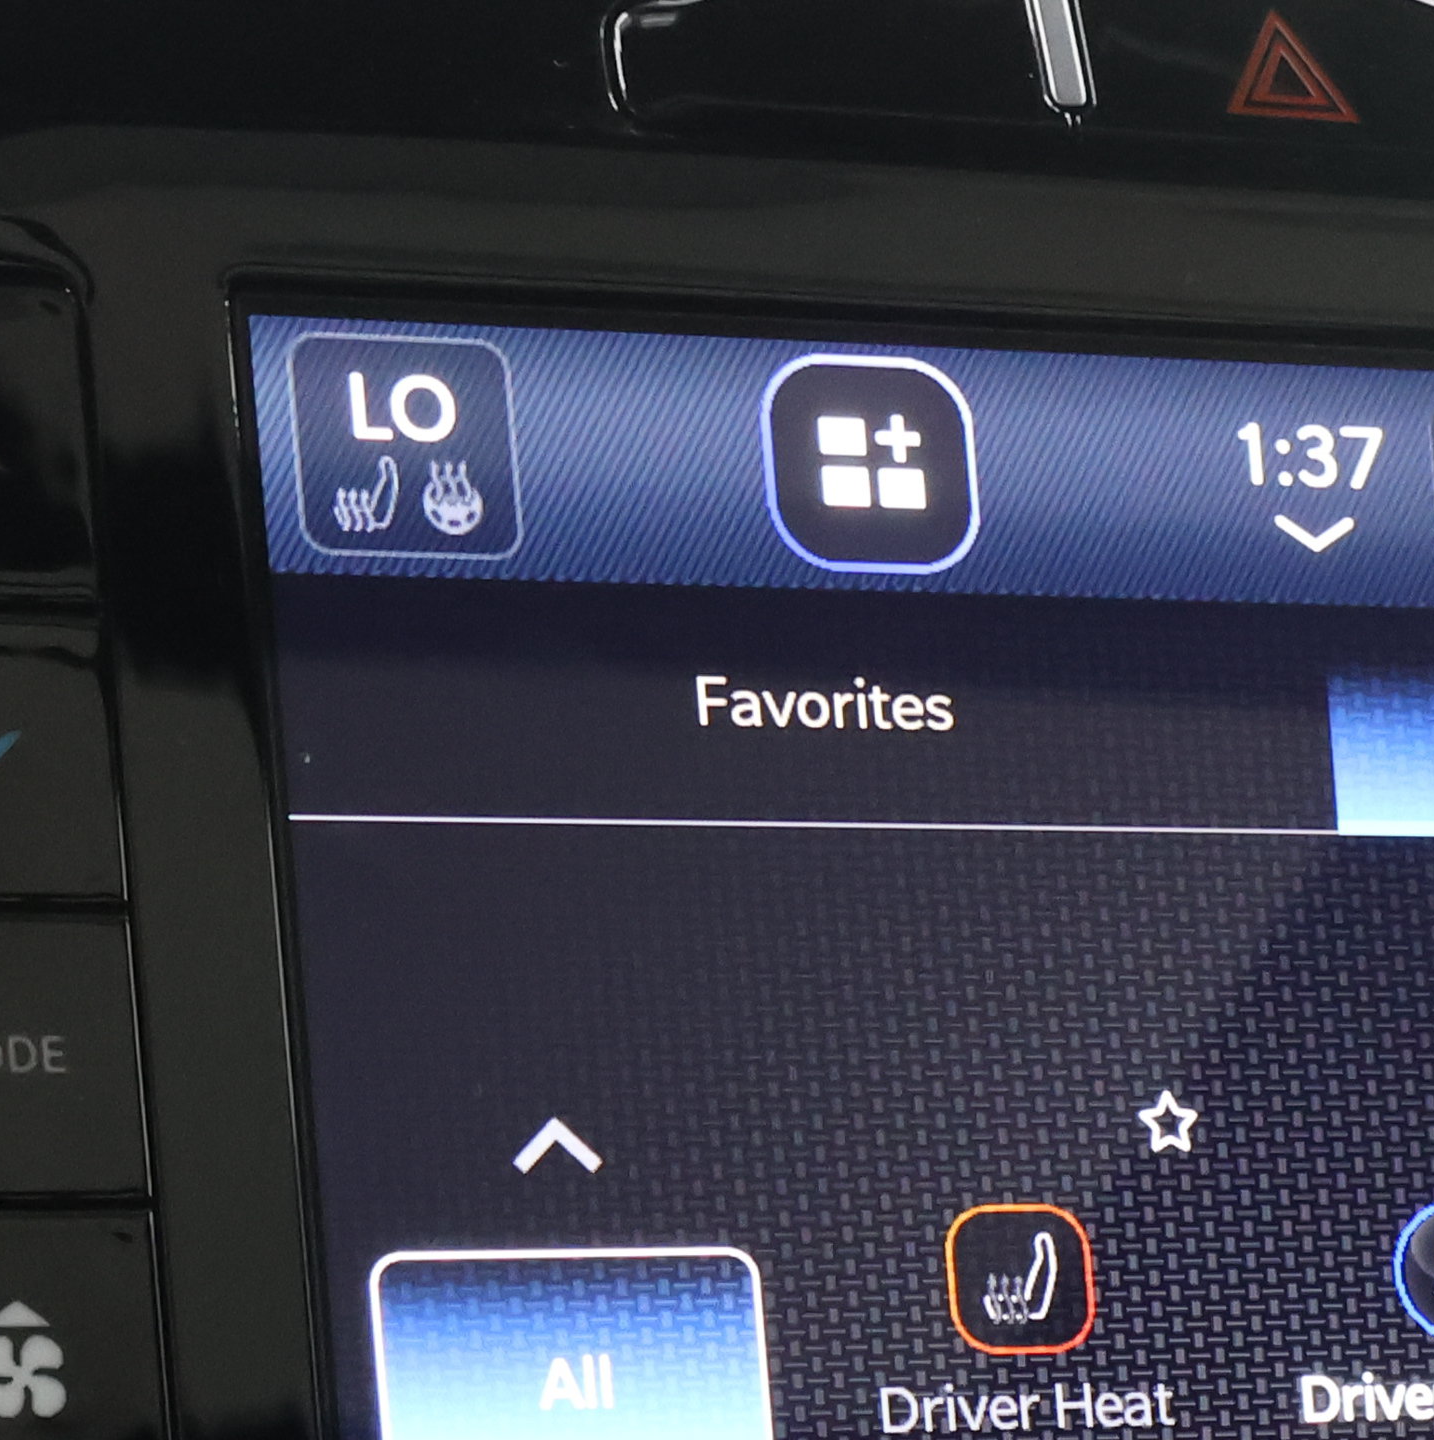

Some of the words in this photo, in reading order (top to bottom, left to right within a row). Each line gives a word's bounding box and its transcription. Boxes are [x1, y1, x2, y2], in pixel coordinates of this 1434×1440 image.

[347, 372, 458, 444] LO
[1237, 421, 1383, 489] 1:37
[696, 675, 955, 732] Favorites
[539, 1355, 614, 1411] All
[880, 1386, 1039, 1434] Driver
[1055, 1384, 1175, 1430] Heat
